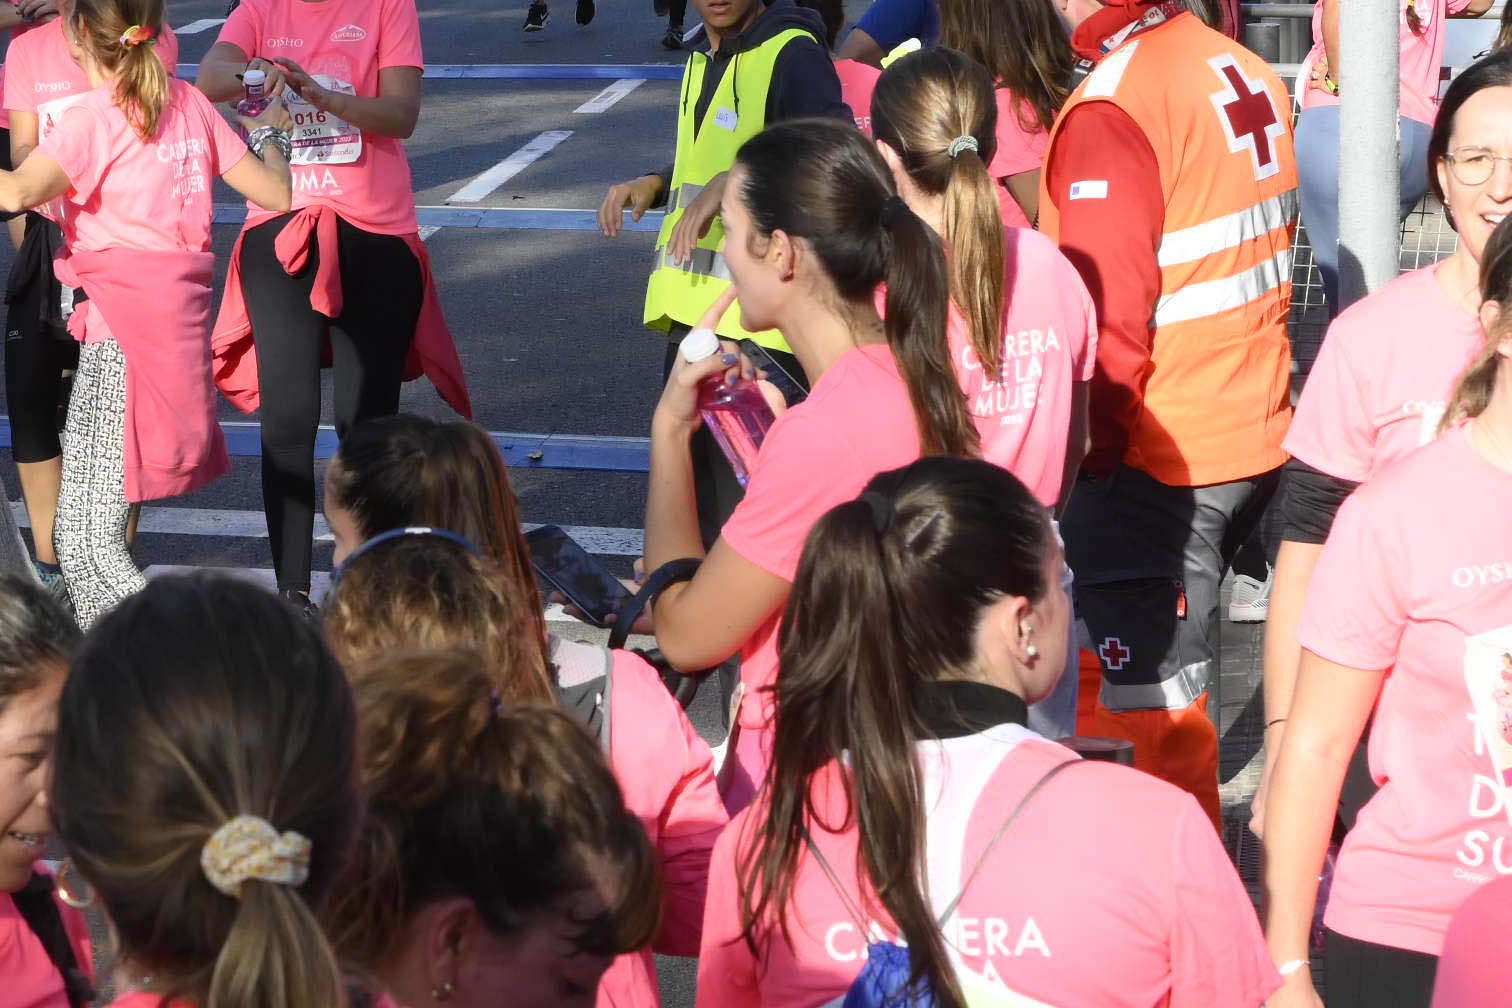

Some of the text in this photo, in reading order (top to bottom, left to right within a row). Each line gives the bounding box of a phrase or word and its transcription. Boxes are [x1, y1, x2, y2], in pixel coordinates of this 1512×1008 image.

[294, 110, 327, 125] 016
[302, 128, 322, 137] 3341
[292, 168, 339, 192] MA
[961, 327, 1060, 370] CRERA
[1015, 356, 1043, 383] LA
[974, 383, 1043, 417] MUJE
